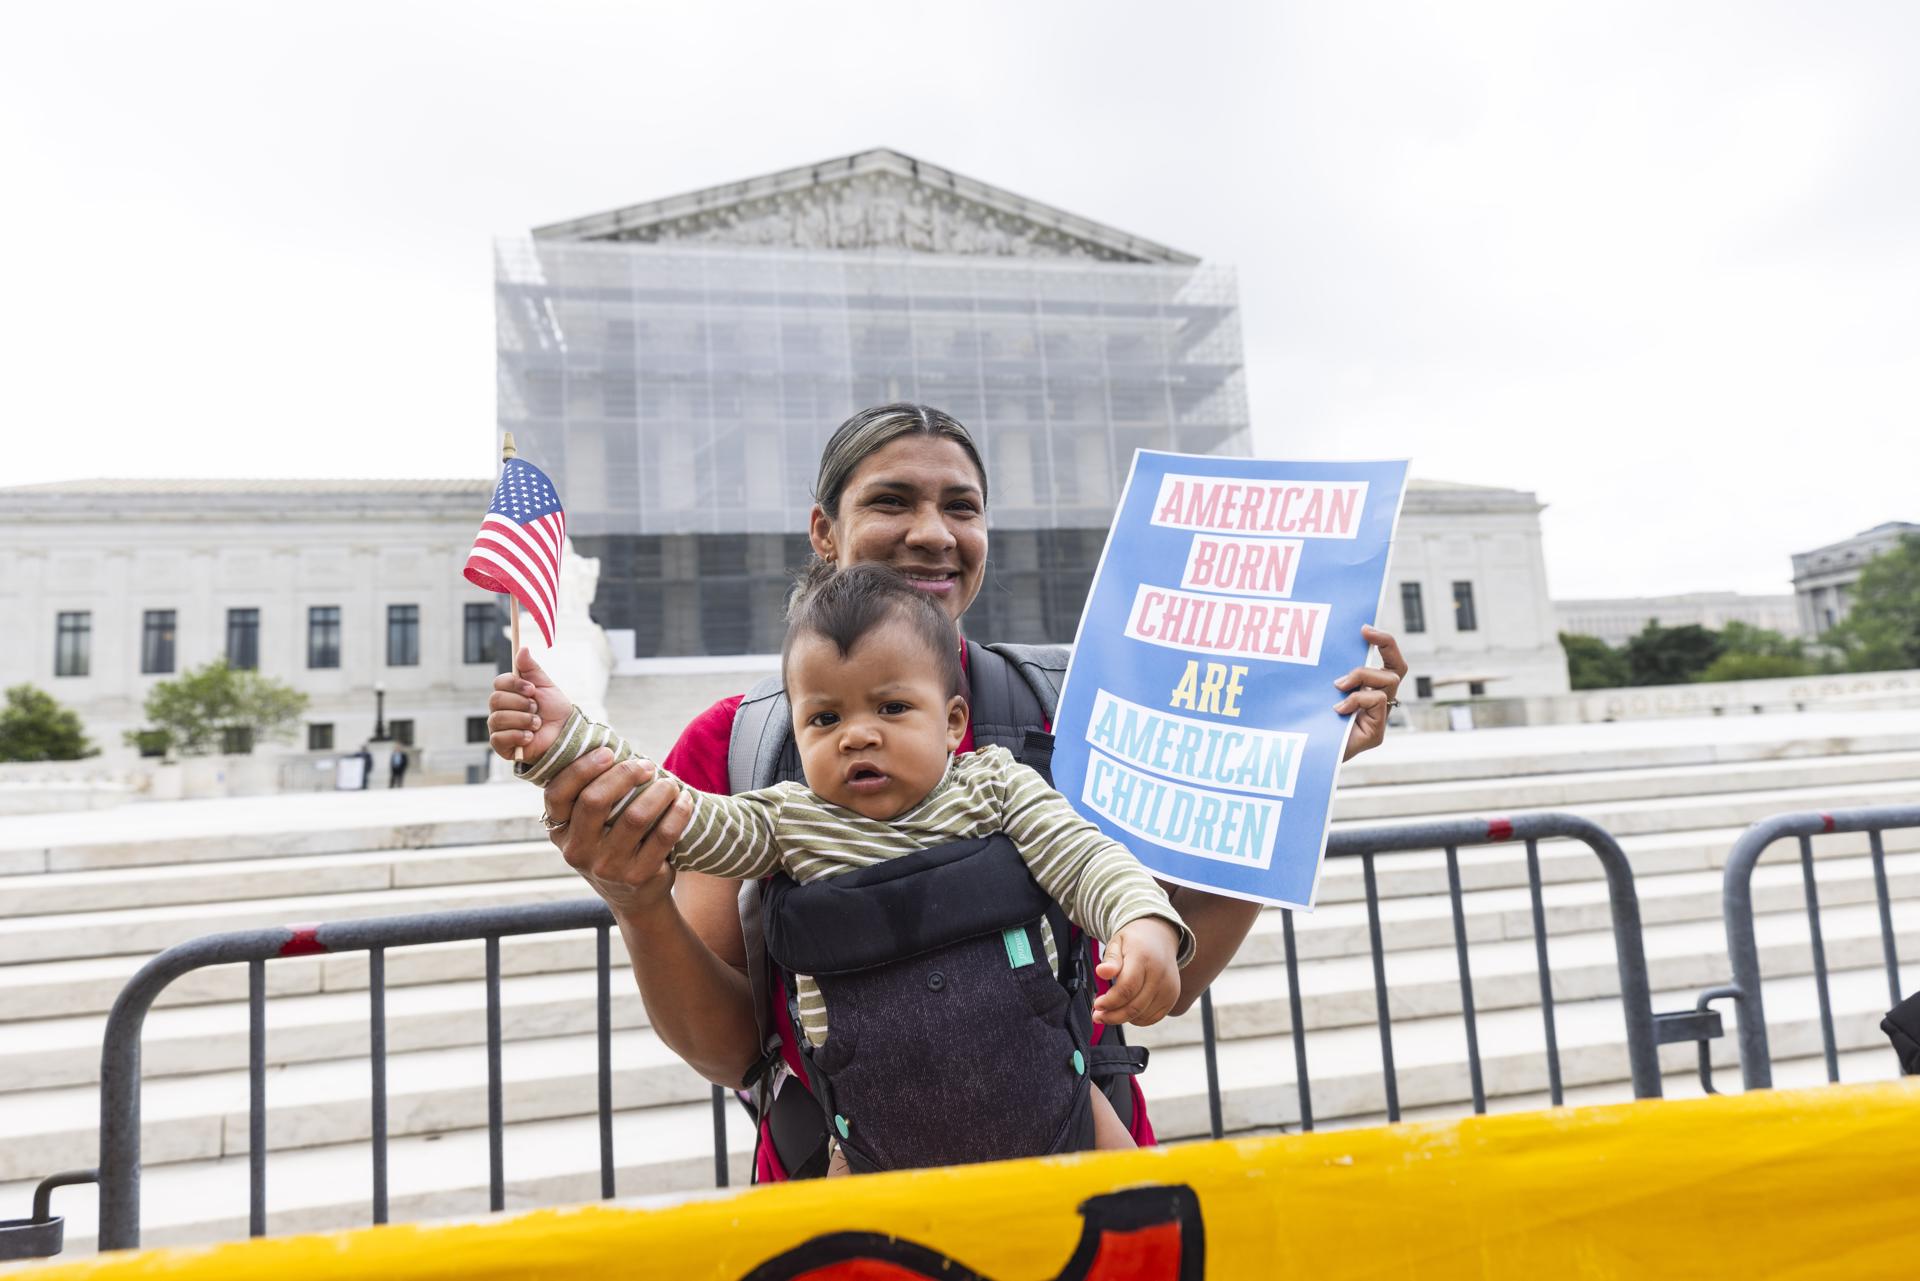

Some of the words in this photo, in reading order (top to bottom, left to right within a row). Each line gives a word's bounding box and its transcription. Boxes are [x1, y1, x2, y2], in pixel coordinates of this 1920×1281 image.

[1160, 481, 1358, 533] AMERICAN
[1190, 542, 1294, 591] BORN
[1137, 592, 1319, 658] CHILDREN
[1170, 661, 1248, 717] ARE
[1095, 701, 1298, 790] AMERICAN
[1092, 760, 1270, 859] CHILDREN
